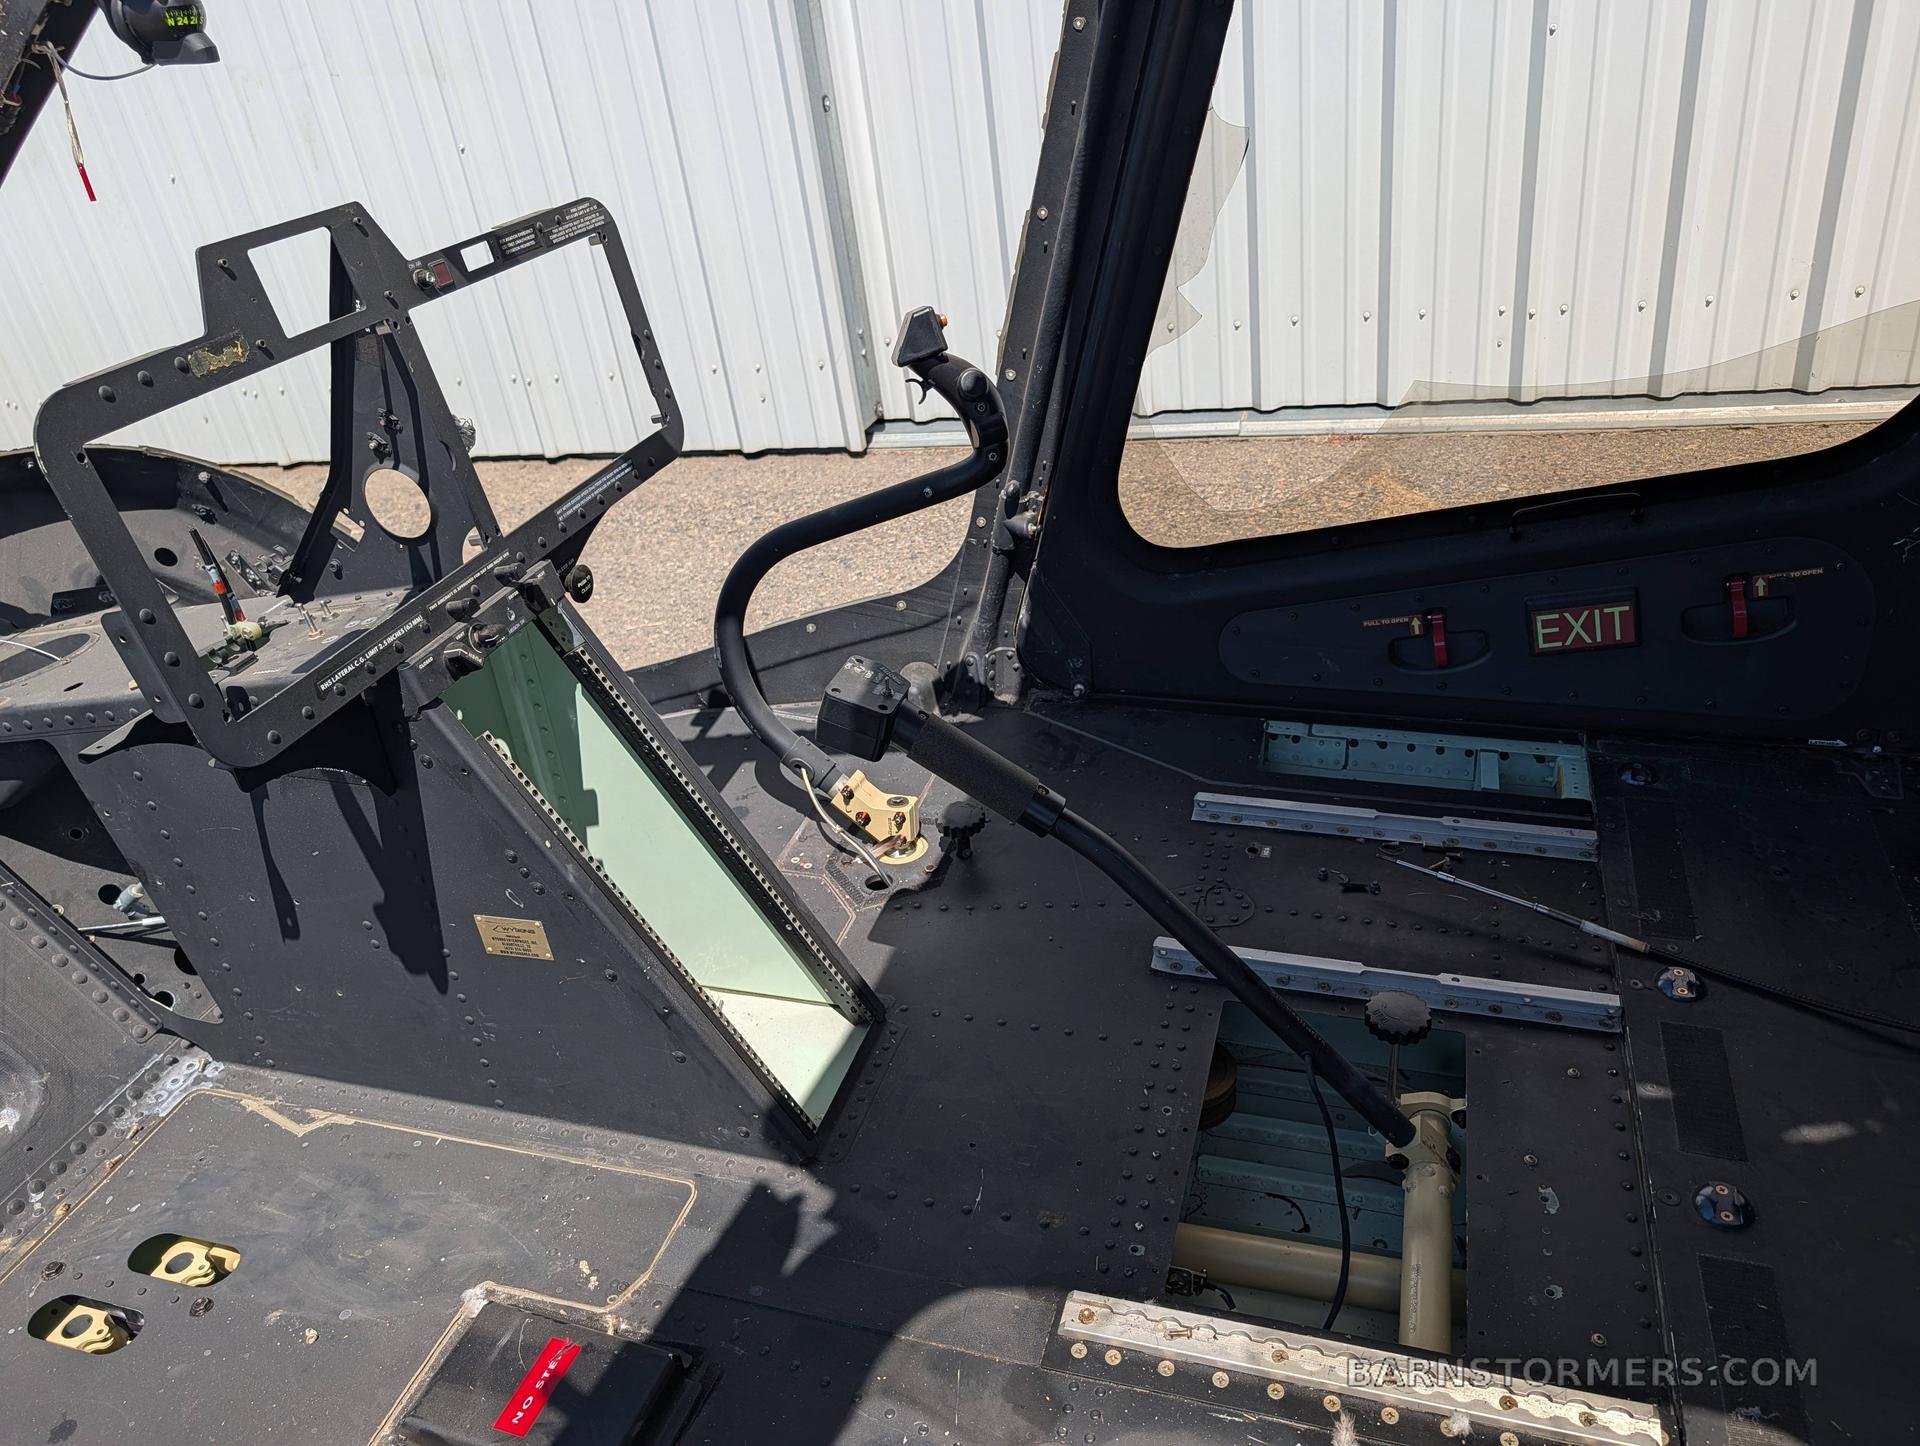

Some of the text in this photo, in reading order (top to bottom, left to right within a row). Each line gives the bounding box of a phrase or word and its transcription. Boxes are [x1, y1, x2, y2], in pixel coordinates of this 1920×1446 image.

[167, 18, 175, 26] N
[177, 17, 188, 26] 24
[1802, 568, 1824, 576] OPEN
[1363, 619, 1380, 627] PULL
[1391, 616, 1409, 624] OPEN
[1536, 605, 1630, 649] EXIT
[320, 679, 333, 691] RHS
[330, 663, 356, 684] LATERAL
[364, 646, 380, 659] LIMIT
[386, 628, 405, 644] INCHES
[418, 656, 434, 670] CLOSED
[511, 1352, 563, 1424] NO STE
